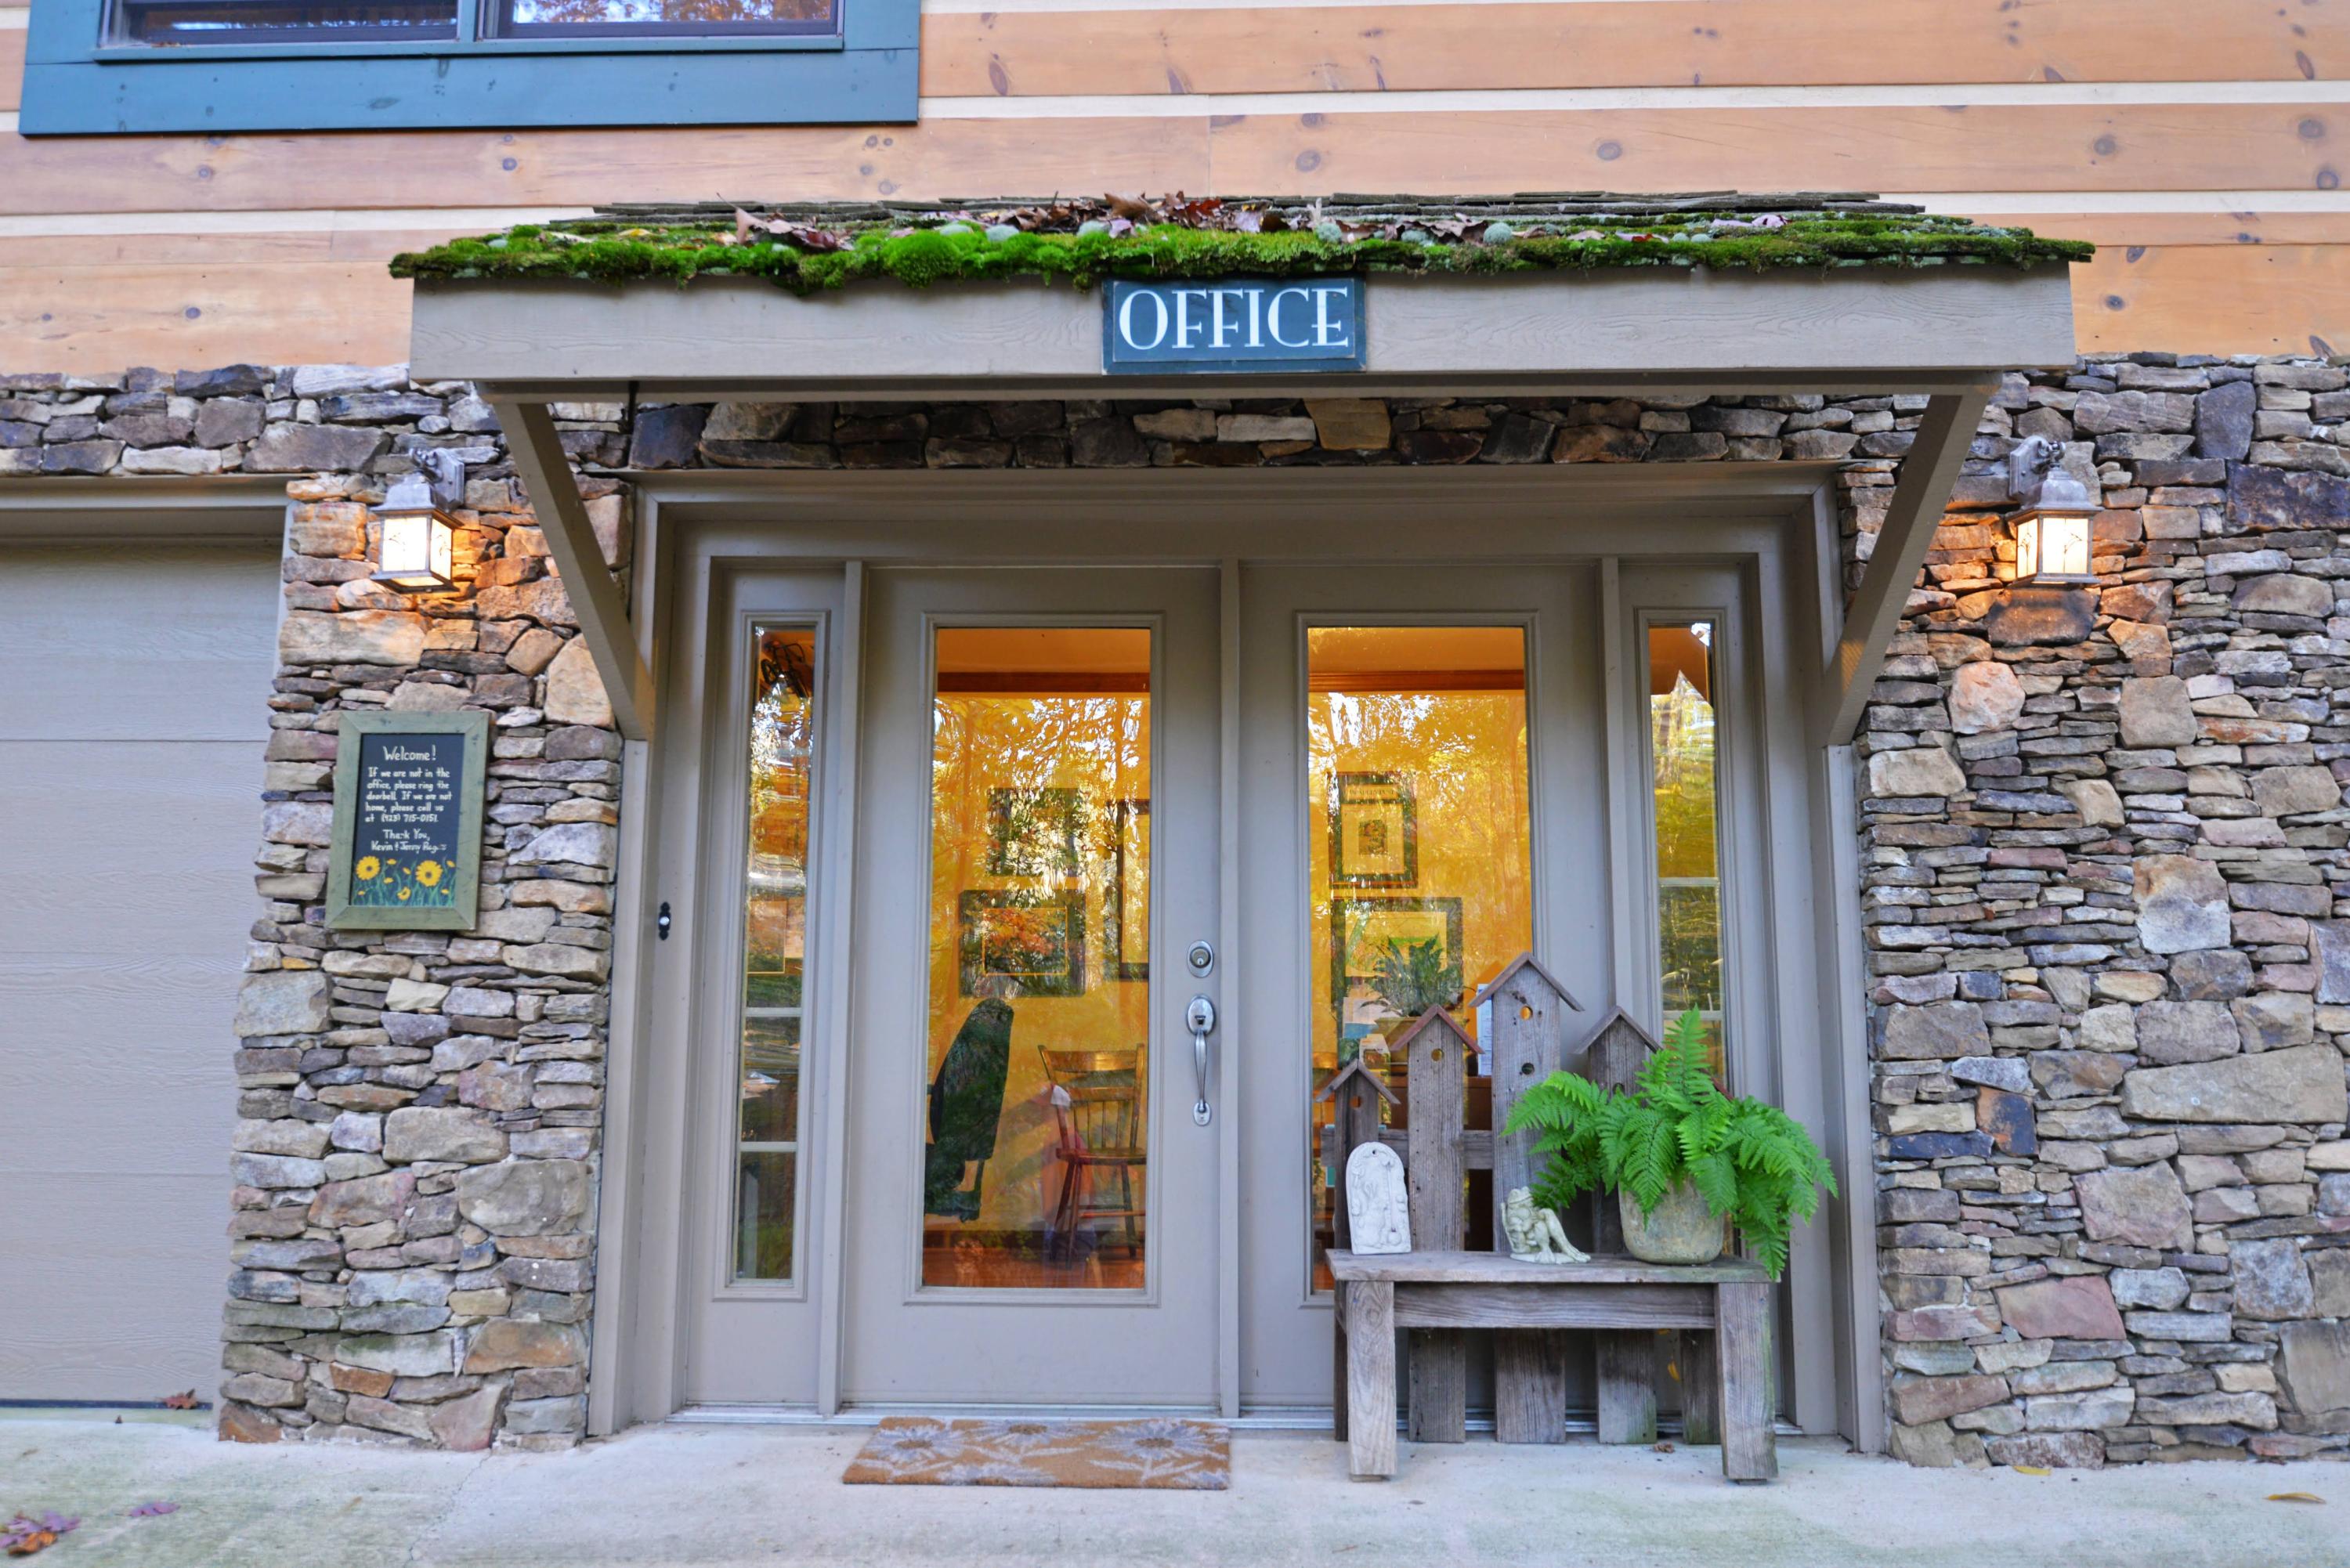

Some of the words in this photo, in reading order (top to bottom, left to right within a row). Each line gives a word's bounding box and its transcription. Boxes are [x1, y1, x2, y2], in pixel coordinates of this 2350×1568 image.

[1119, 287, 1349, 350] OFFICE
[382, 744, 436, 761] Welcome!
[368, 767, 378, 778] If
[409, 768, 423, 778] not
[425, 769, 433, 778] in
[436, 768, 450, 778] the
[367, 779, 391, 789] office,
[394, 780, 417, 791] please
[418, 782, 434, 792] ring
[436, 780, 450, 789] the
[401, 791, 412, 800] If
[439, 791, 453, 800] not
[365, 801, 387, 813] home,
[390, 801, 414, 813] please
[417, 801, 432, 811] call
[364, 813, 374, 822] at
[414, 829, 430, 841] You,
[371, 840, 393, 851] Kevin
[400, 840, 421, 854] Jenny
